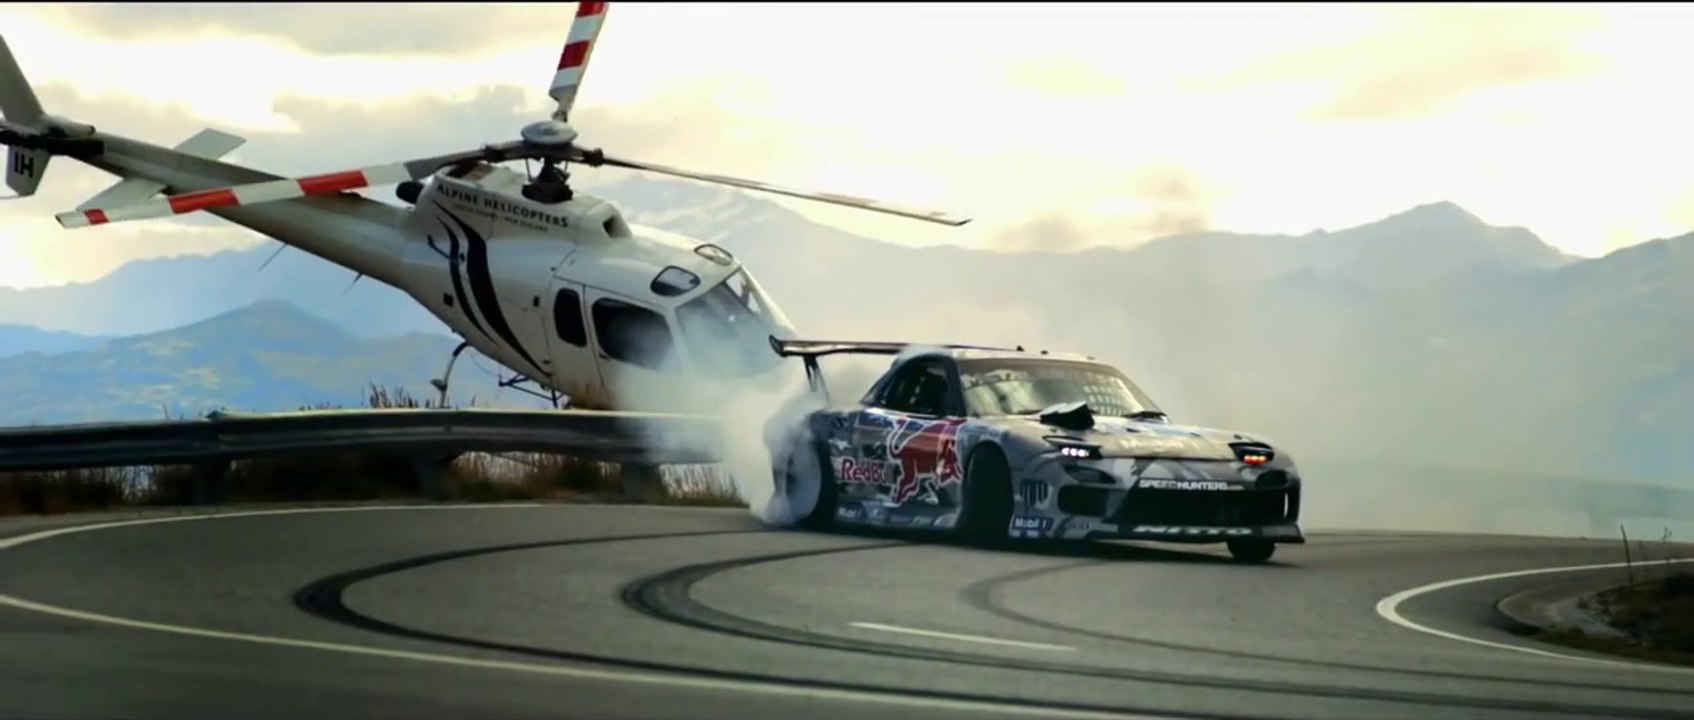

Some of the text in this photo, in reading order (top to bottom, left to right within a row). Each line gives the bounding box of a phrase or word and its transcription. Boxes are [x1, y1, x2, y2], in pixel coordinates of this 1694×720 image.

[14, 151, 34, 178] IH
[437, 183, 478, 204] ALPINE
[484, 198, 569, 228] HELICOPTERS
[1015, 518, 1039, 528] Mobil
